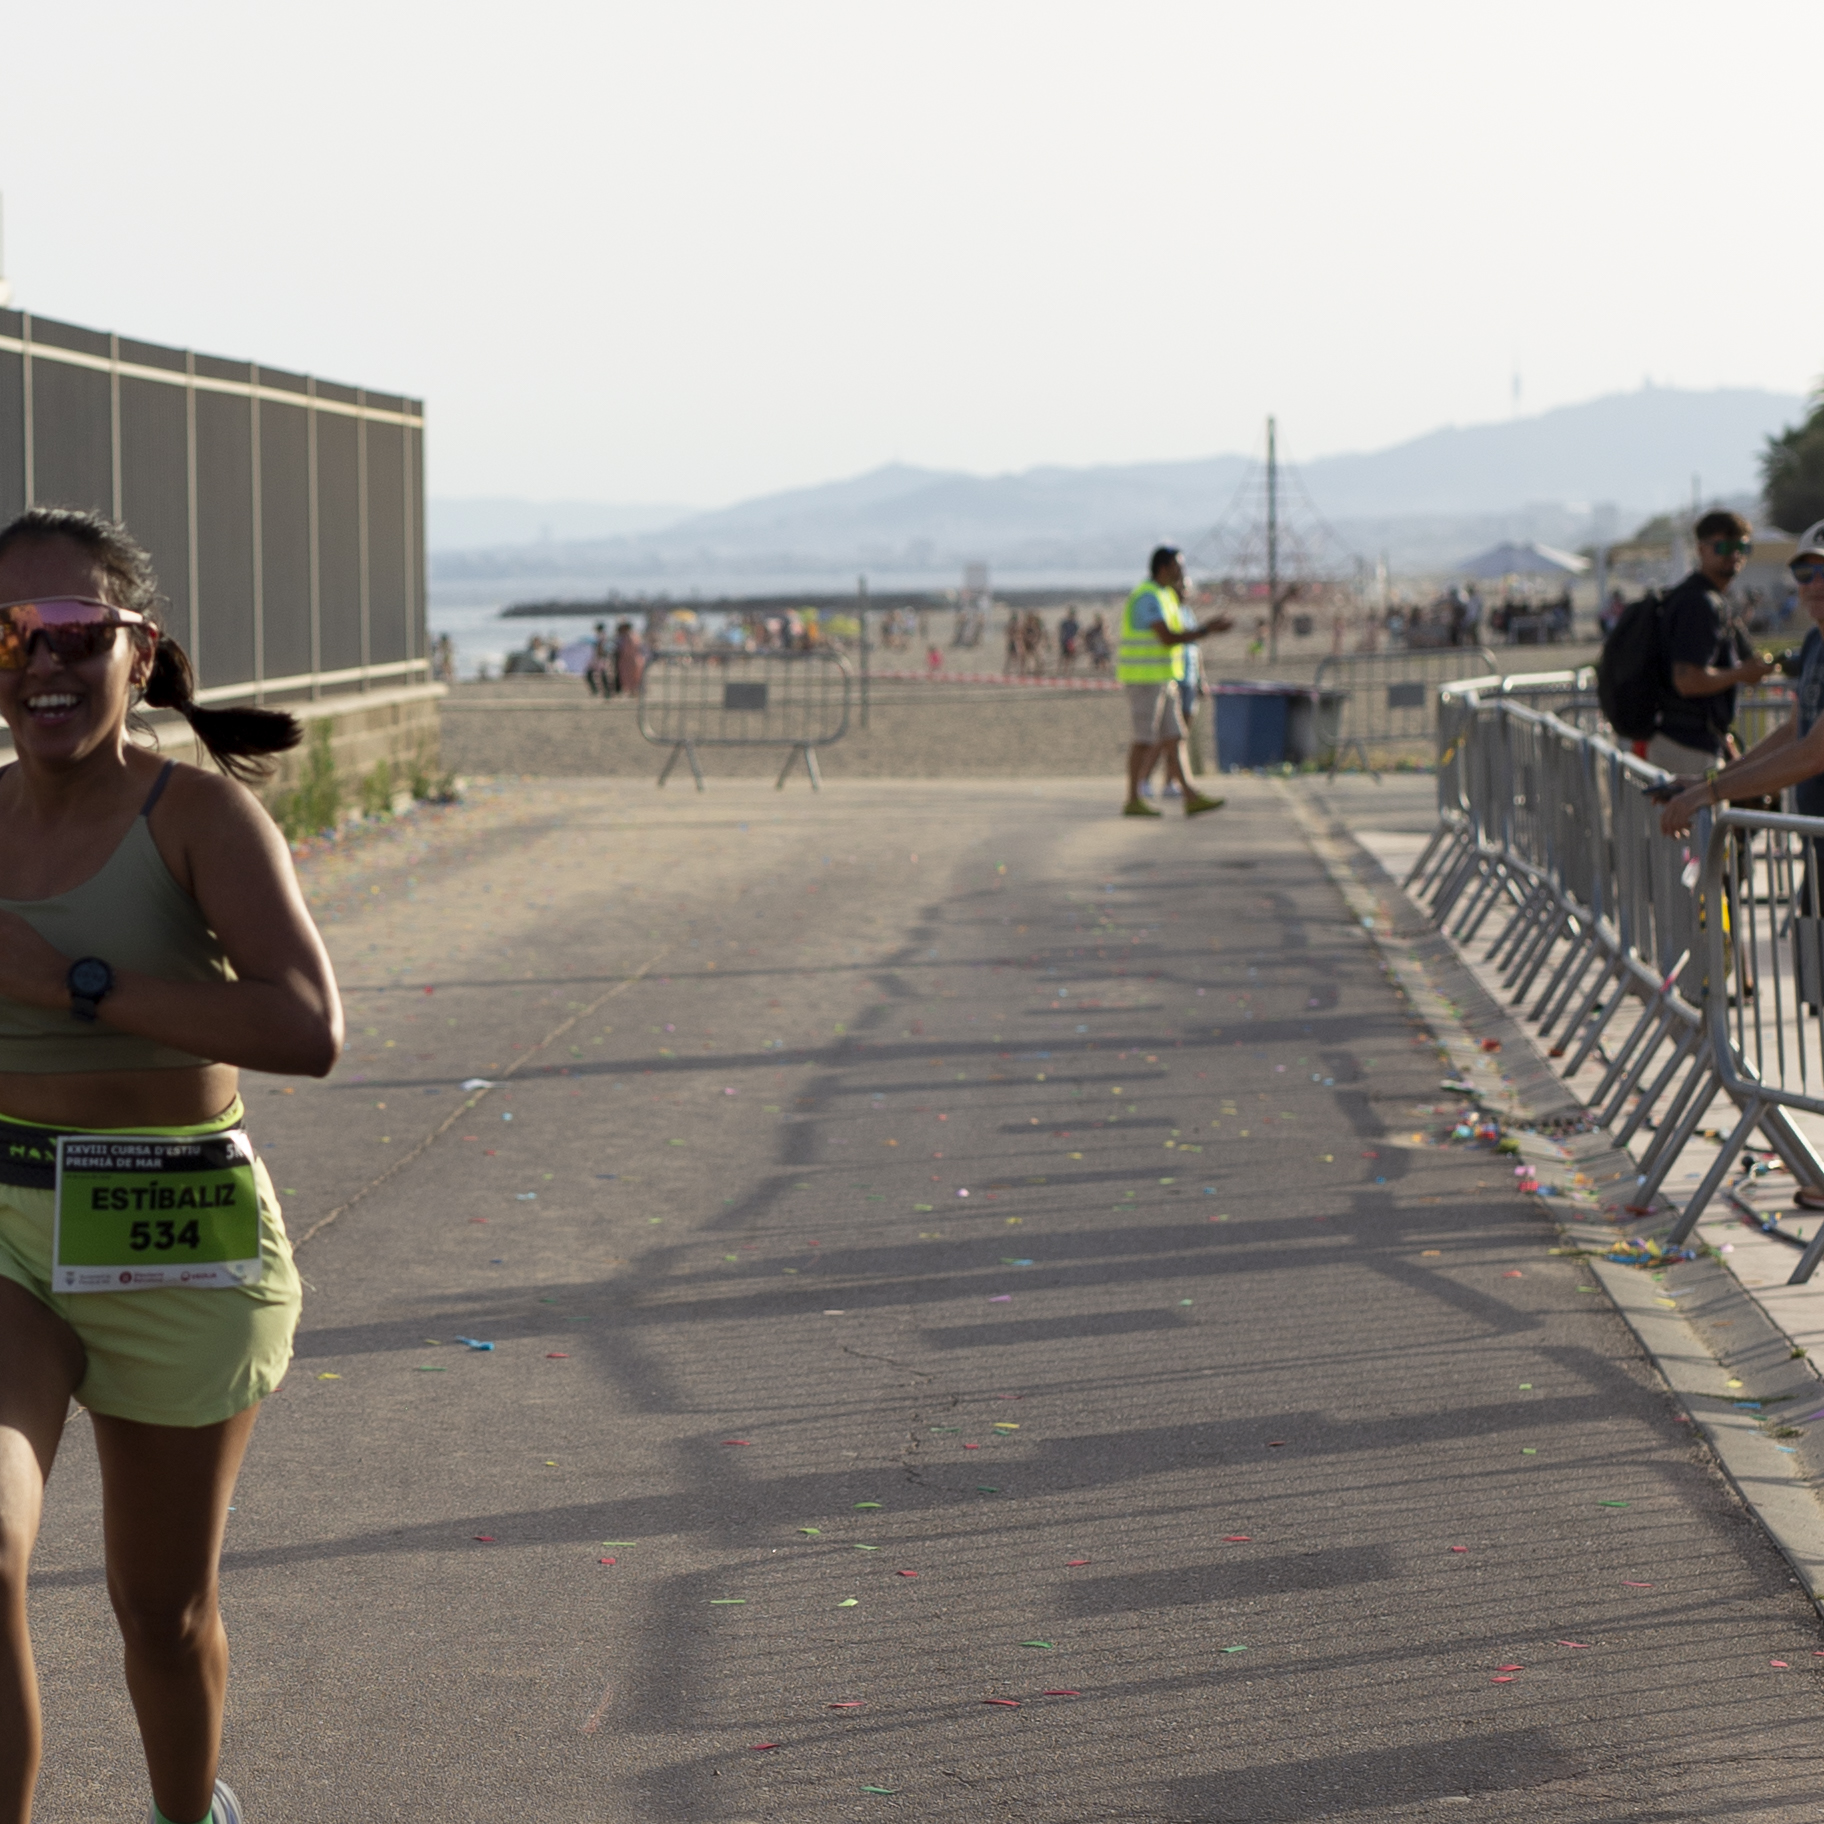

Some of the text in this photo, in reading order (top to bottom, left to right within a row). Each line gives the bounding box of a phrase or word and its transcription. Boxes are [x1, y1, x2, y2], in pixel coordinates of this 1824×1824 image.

[111, 1145, 151, 1155] CURSA
[155, 1145, 202, 1156] D'ESTIU
[65, 1155, 163, 1169] PREMIÀ DE MAR
[91, 1180, 236, 1210] ESTÍBALIZ
[129, 1219, 201, 1251] 534
